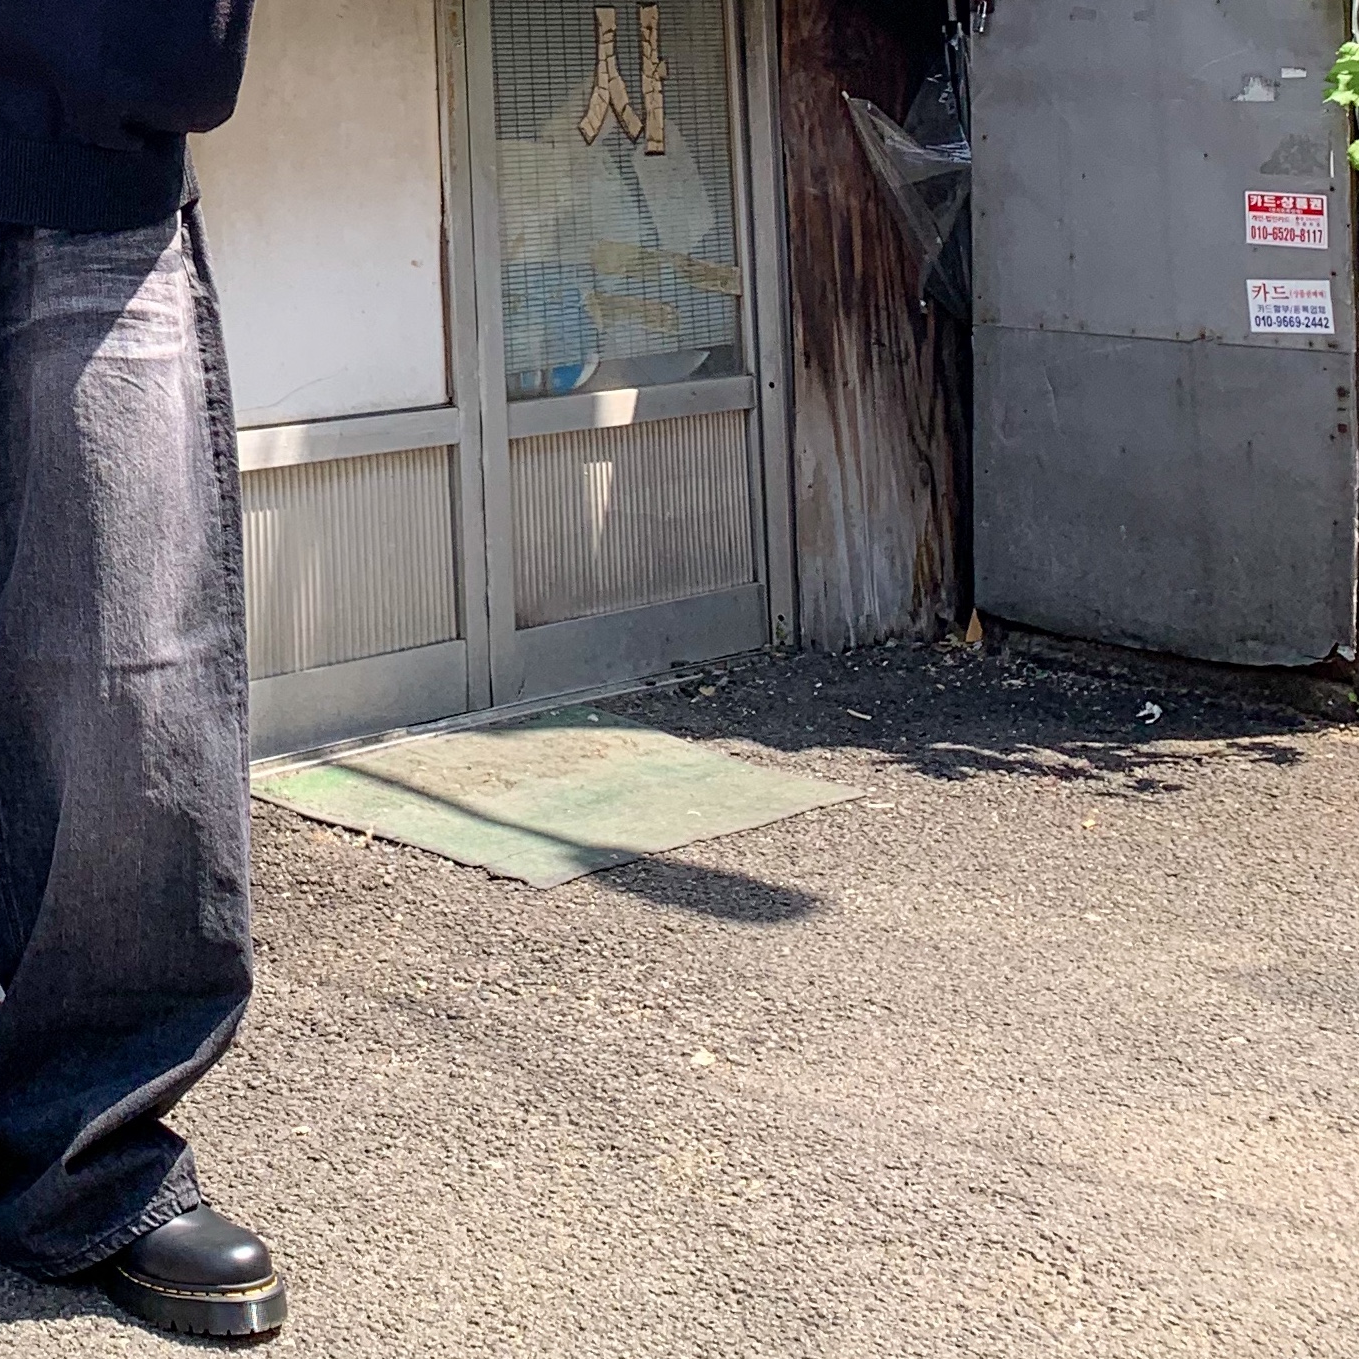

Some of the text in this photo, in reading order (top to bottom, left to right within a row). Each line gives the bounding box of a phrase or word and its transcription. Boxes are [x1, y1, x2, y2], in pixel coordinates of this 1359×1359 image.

[1251, 226, 1323, 243] 010-6520-8117
[1251, 282, 1290, 303] 카드
[1254, 315, 1331, 329] 010-9669-2442
